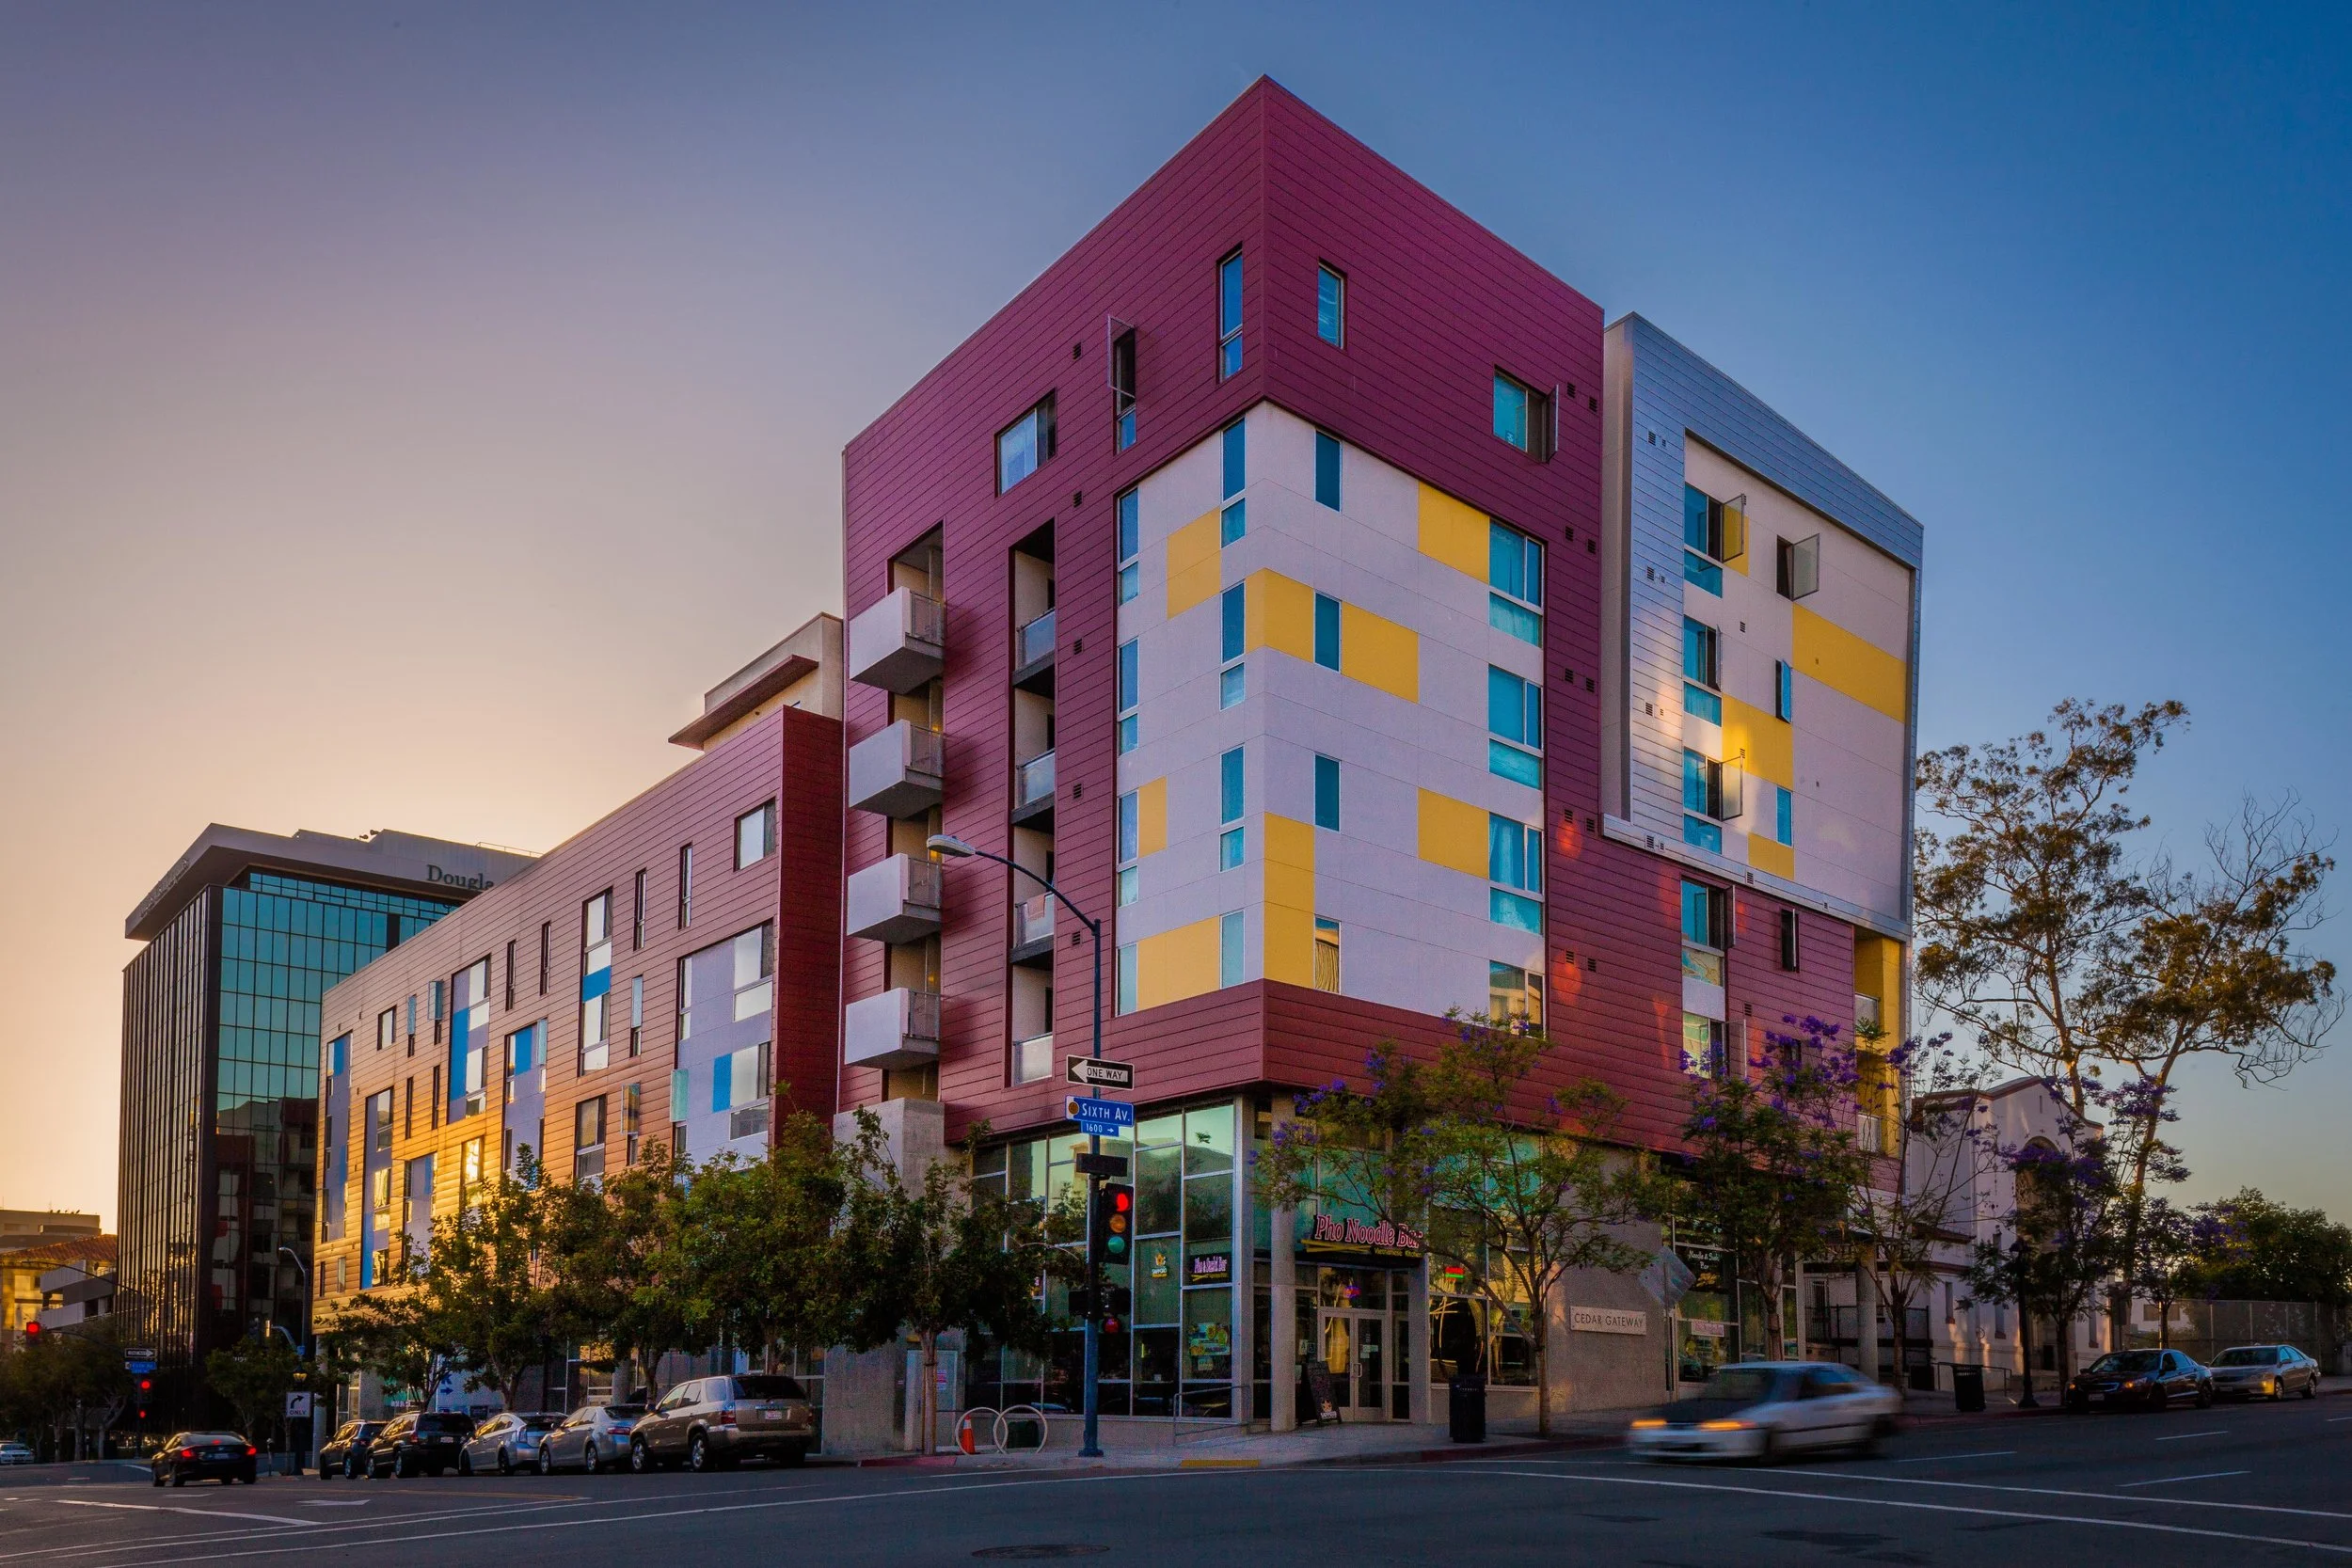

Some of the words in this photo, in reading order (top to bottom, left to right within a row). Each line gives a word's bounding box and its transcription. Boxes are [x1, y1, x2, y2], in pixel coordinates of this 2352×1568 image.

[1087, 1068, 1103, 1077] ONE
[1106, 1070, 1122, 1080] WAY
[1086, 1123, 1103, 1132] 1600
[1315, 1214, 1343, 1241] Pho
[1345, 1218, 1395, 1245] Noodle
[1396, 1223, 1423, 1248] Bar
[1574, 1313, 1602, 1325] CEDAR
[1605, 1315, 1644, 1328] GATEWAY
